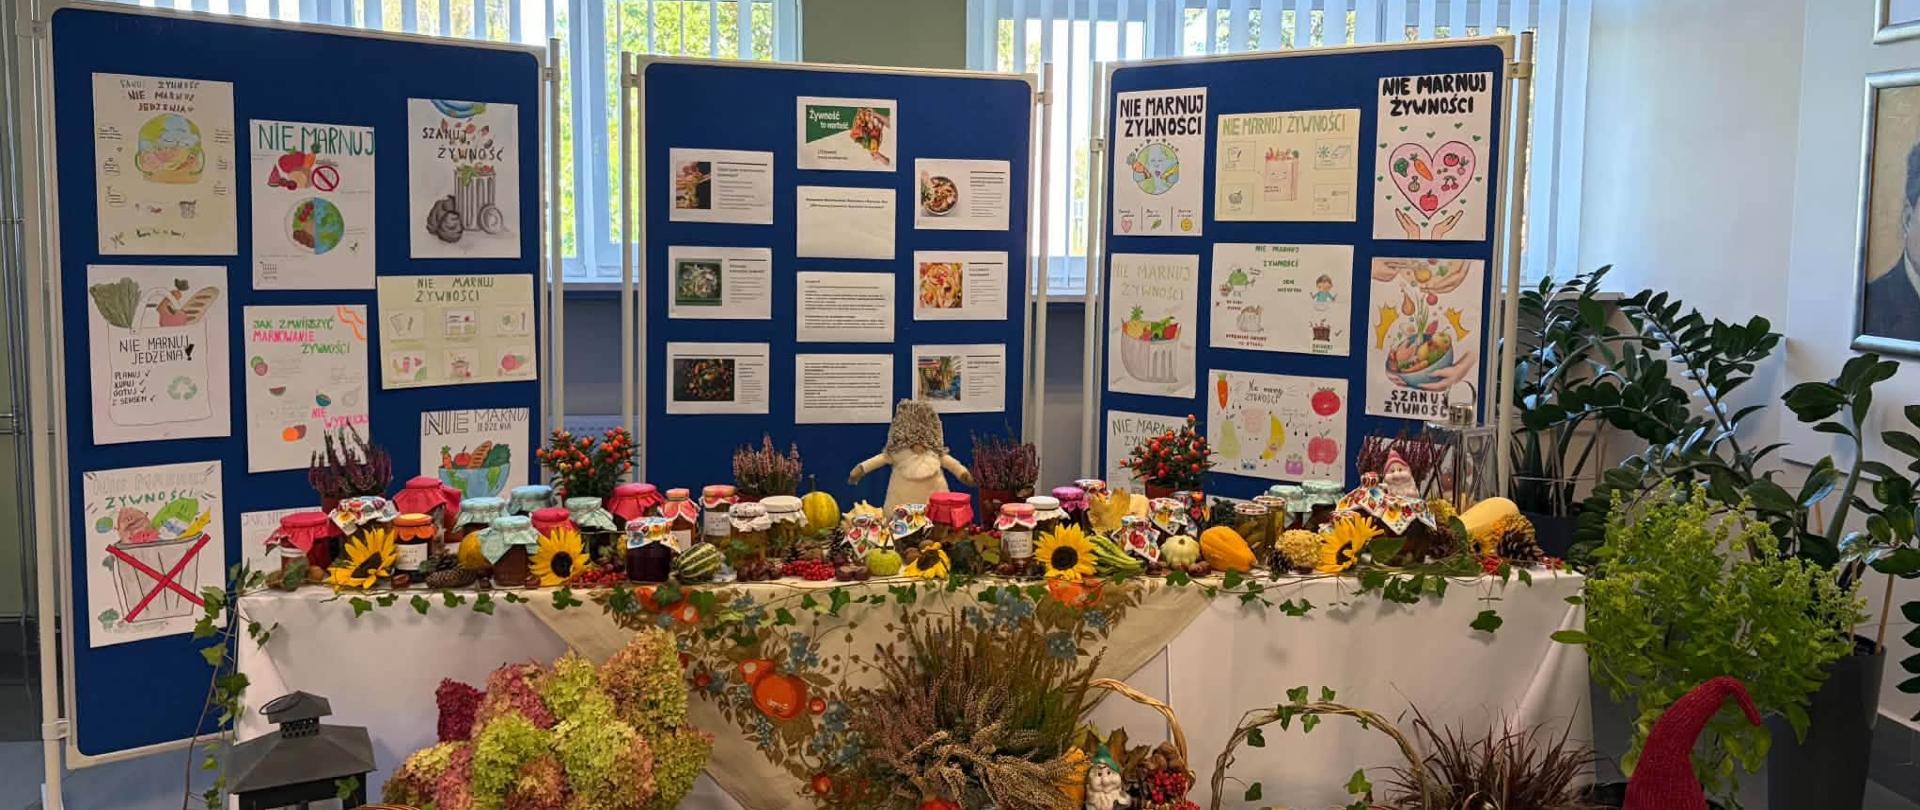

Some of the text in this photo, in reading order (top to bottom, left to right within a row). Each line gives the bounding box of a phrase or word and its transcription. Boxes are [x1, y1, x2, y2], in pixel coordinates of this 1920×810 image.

[1382, 74, 1487, 96] NIE MARNUJ
[128, 90, 145, 100] NIE
[1120, 94, 1204, 118] NIE MARNUJ
[1390, 94, 1474, 116] ŻYWNOŚCI
[808, 107, 841, 122] Żywność
[1242, 116, 1283, 135] MARNUJ
[1287, 111, 1346, 134] ŻYWNOŚCI
[1125, 115, 1202, 138] ŻYWNOŚCI
[258, 122, 295, 152] NIE
[301, 126, 376, 156] MARNUJ
[417, 276, 494, 289] NIE MARNUJ
[253, 320, 273, 329] JAK
[119, 335, 190, 353] NIE MARNUJ
[114, 370, 141, 380] PLANUJ
[113, 388, 138, 397] GOTUJ
[114, 380, 135, 389] KUPUJ
[425, 410, 470, 436] NIE
